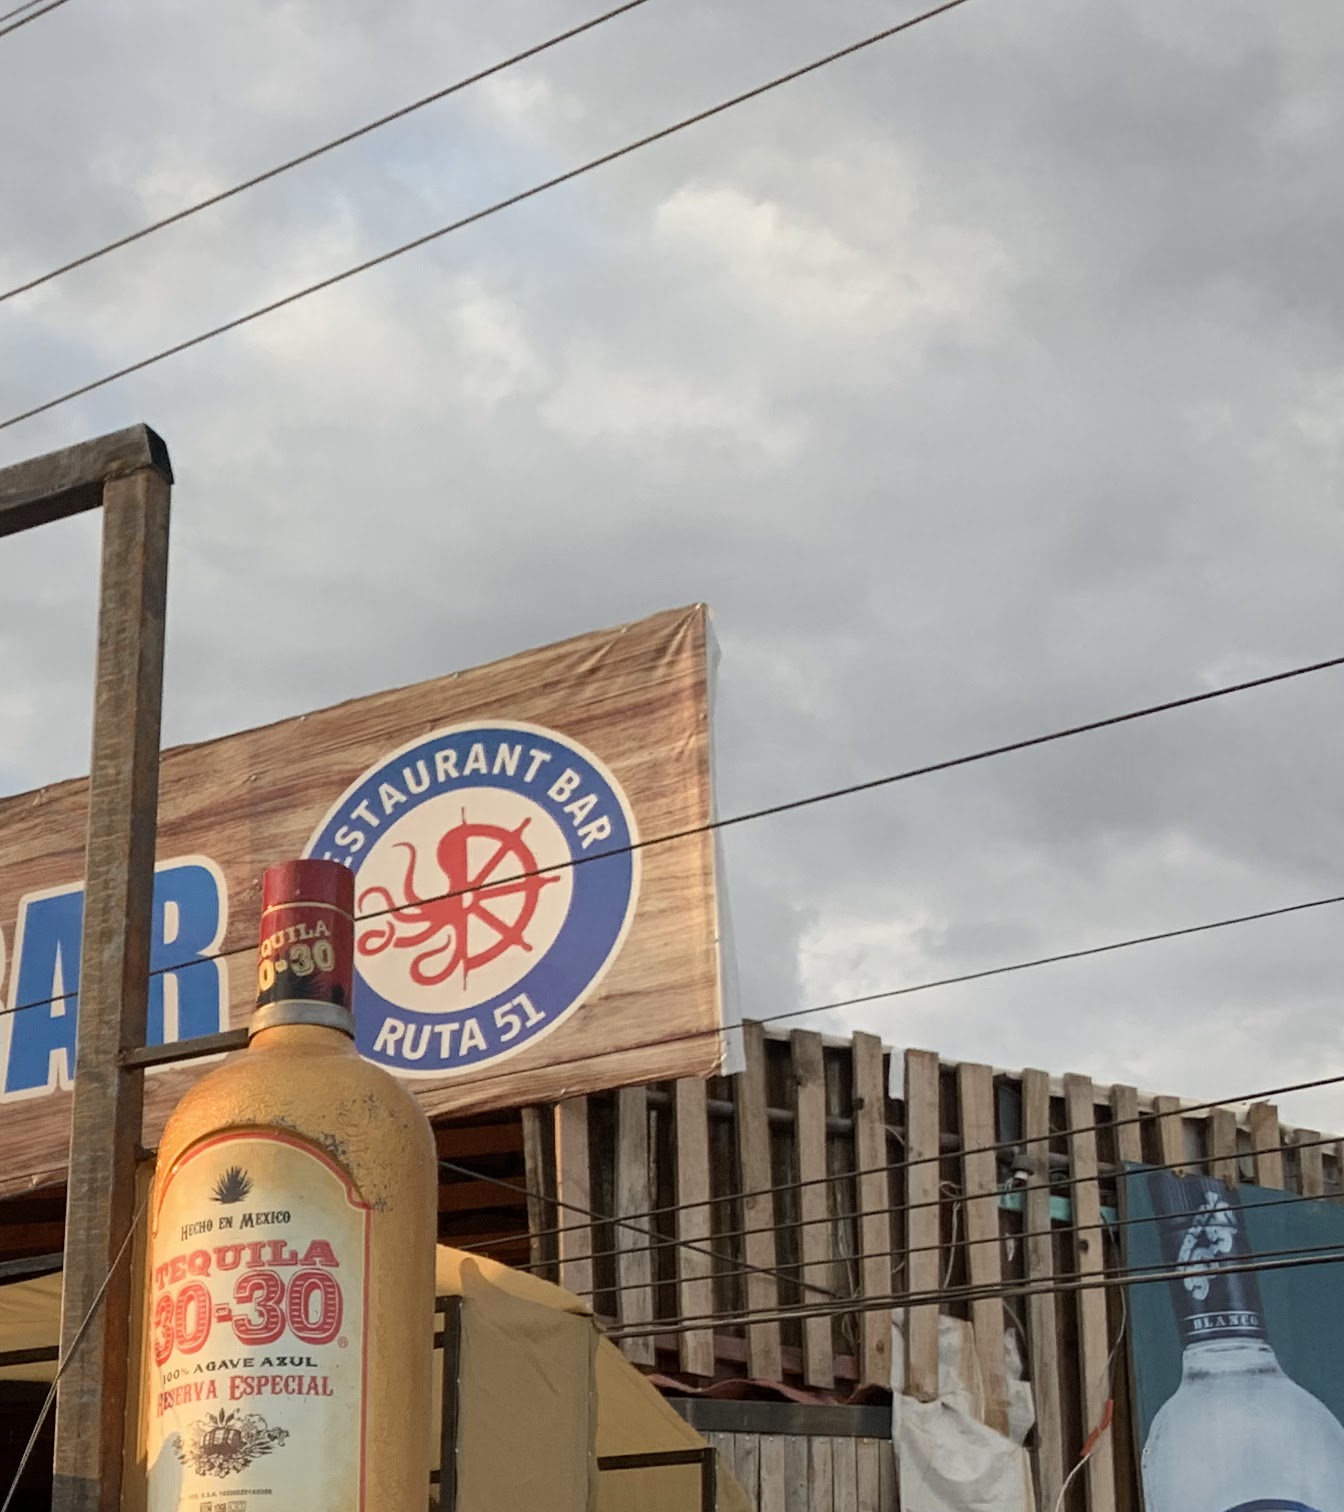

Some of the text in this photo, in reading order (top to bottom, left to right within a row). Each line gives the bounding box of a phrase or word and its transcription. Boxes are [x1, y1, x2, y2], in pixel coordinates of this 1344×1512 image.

[322, 741, 612, 868] STAURANT BAR
[261, 919, 331, 958] QUILA
[373, 991, 546, 1061] RUTA 51
[218, 1215, 234, 1230] EN
[239, 1210, 291, 1229] MEXICO
[154, 1239, 340, 1291] TEQUILA
[153, 1267, 344, 1367] 30-30
[1192, 1313, 1259, 1331] BLANCO
[193, 1357, 255, 1374] AGAVE
[260, 1355, 319, 1368] AZUL
[229, 1374, 334, 1401] ESPECIAL
